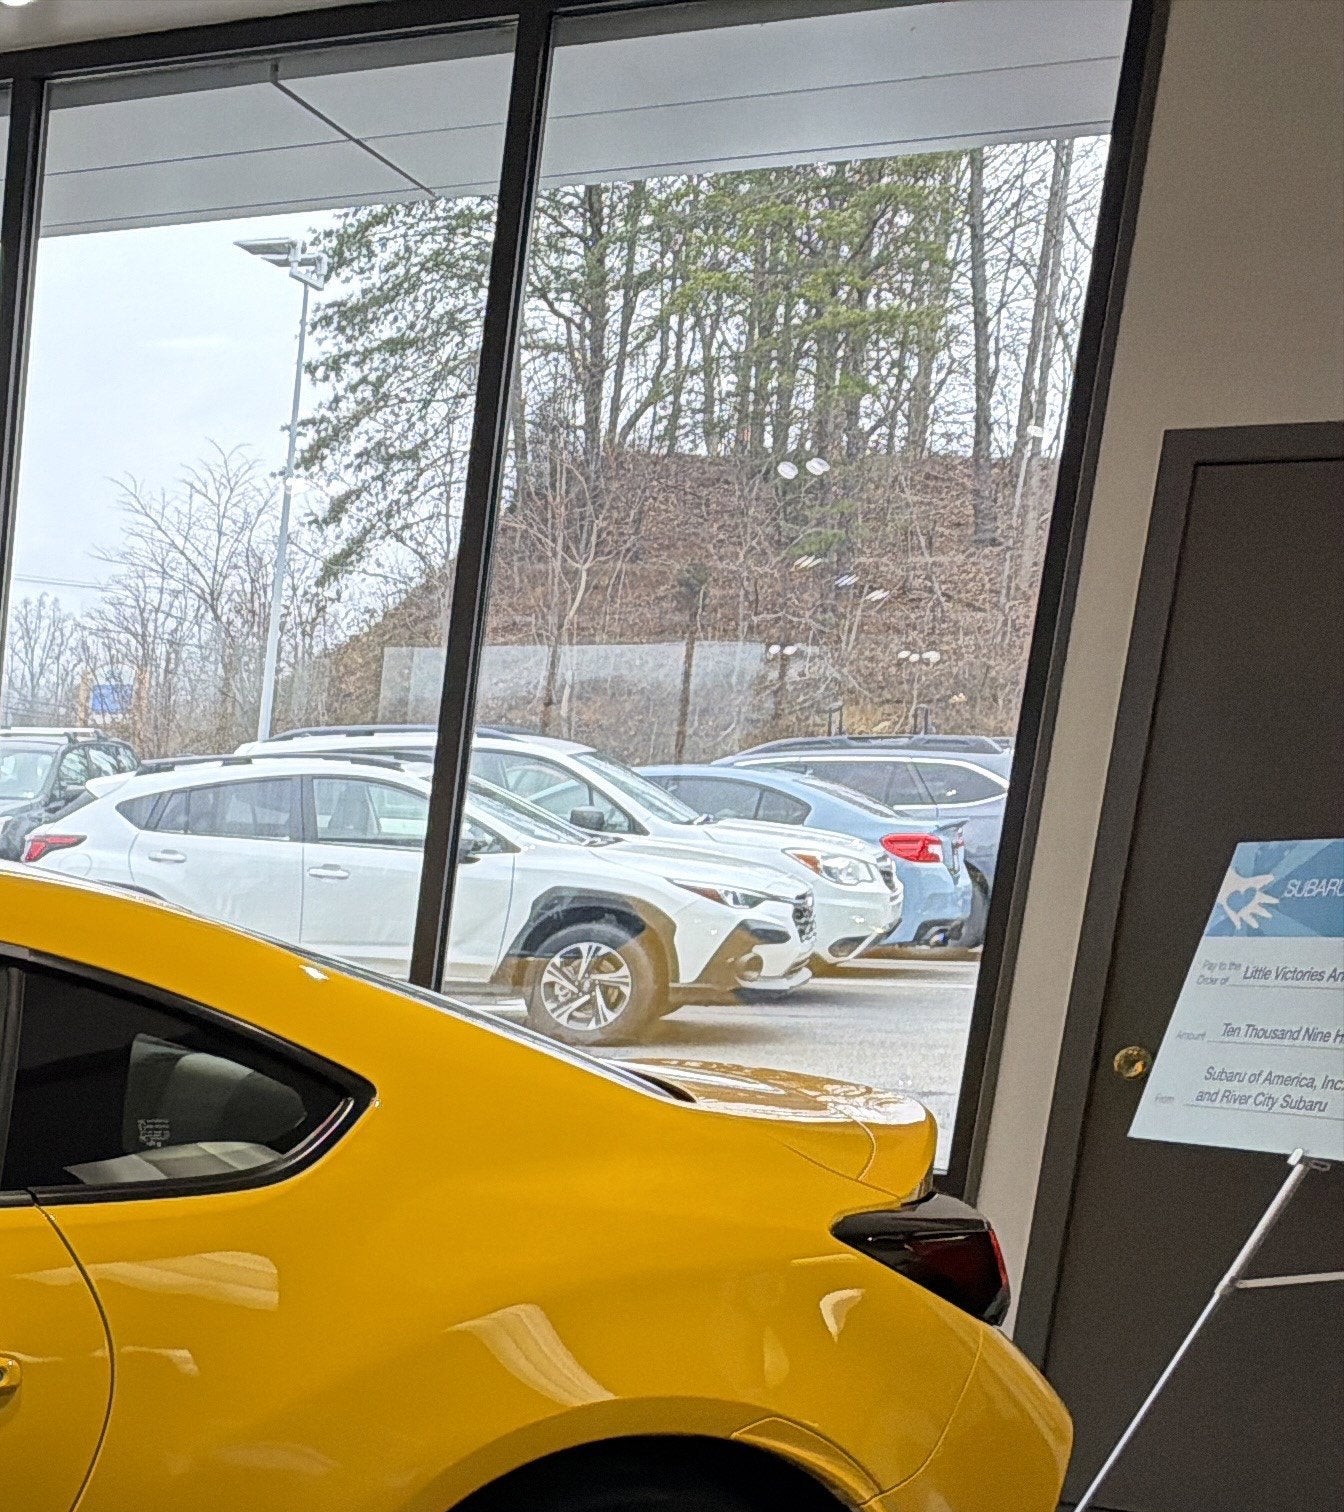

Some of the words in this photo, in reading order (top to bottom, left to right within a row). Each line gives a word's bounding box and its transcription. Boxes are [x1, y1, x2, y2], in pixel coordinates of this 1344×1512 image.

[1243, 965, 1272, 980] Little
[1274, 966, 1325, 981] Victories
[1221, 1022, 1242, 1037] Ten
[1243, 1024, 1302, 1041] Thousand
[1302, 1027, 1331, 1043] Nine
[1204, 1066, 1247, 1082] Subaru
[1248, 1070, 1261, 1084] of
[1262, 1070, 1317, 1090] America,
[1195, 1089, 1219, 1102] and
[1220, 1089, 1253, 1105] River
[1253, 1092, 1278, 1111] City
[1280, 1094, 1328, 1113] Subaru
